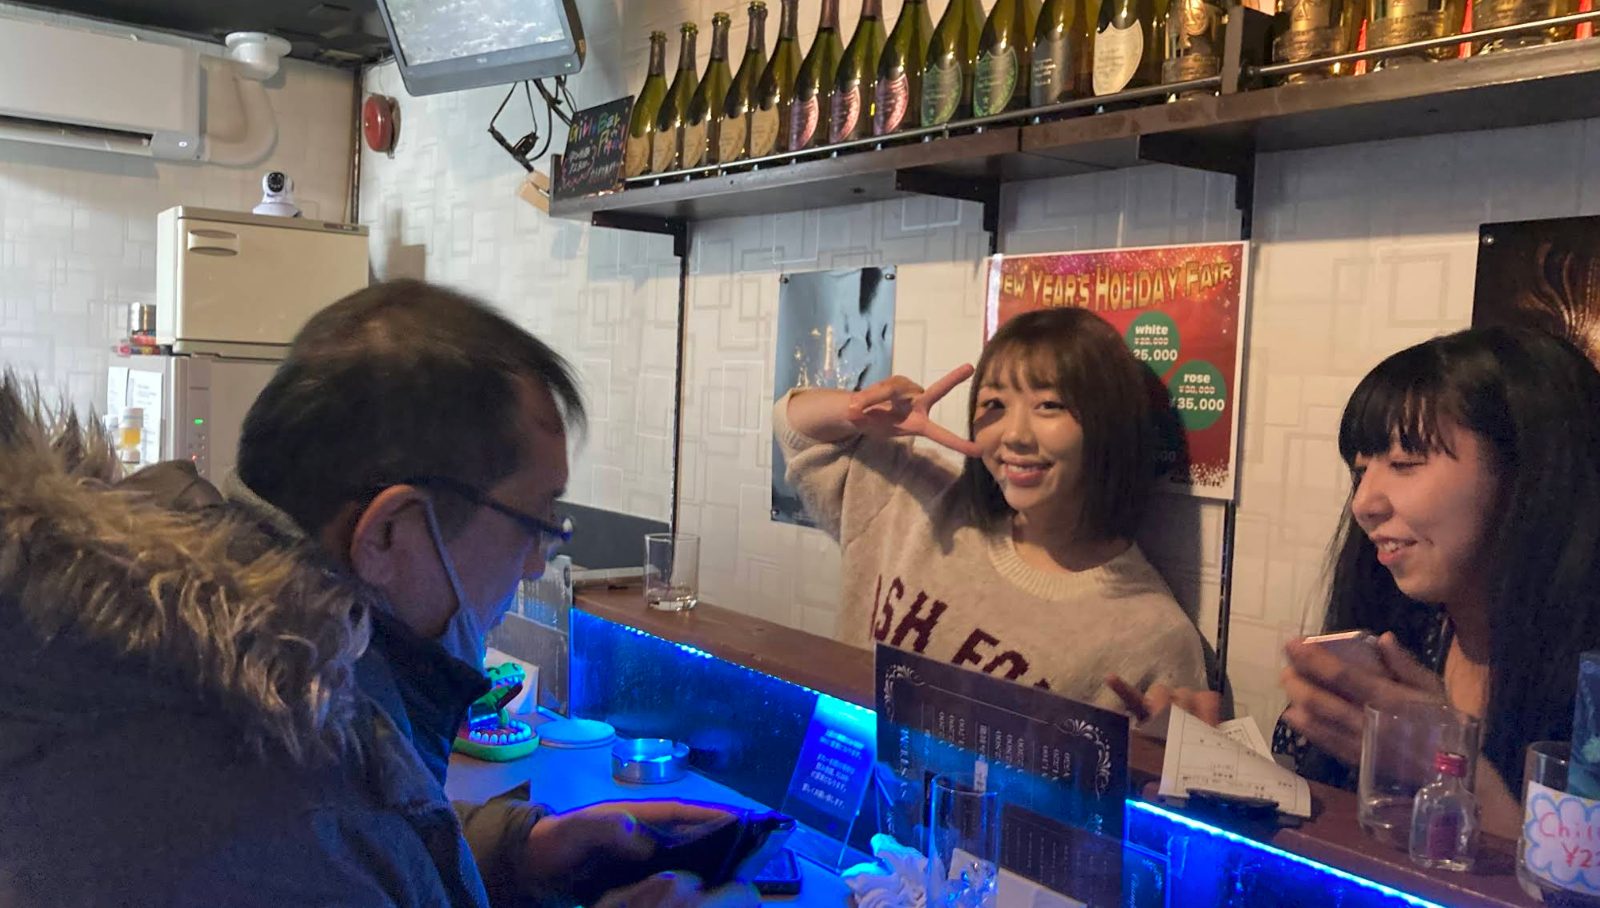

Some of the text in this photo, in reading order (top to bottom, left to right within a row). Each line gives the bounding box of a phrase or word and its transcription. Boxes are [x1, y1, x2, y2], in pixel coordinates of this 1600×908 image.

[1001, 274, 1026, 298] EW
[1135, 324, 1168, 335] white
[1133, 349, 1178, 361] 25,000
[1183, 373, 1211, 384] rose
